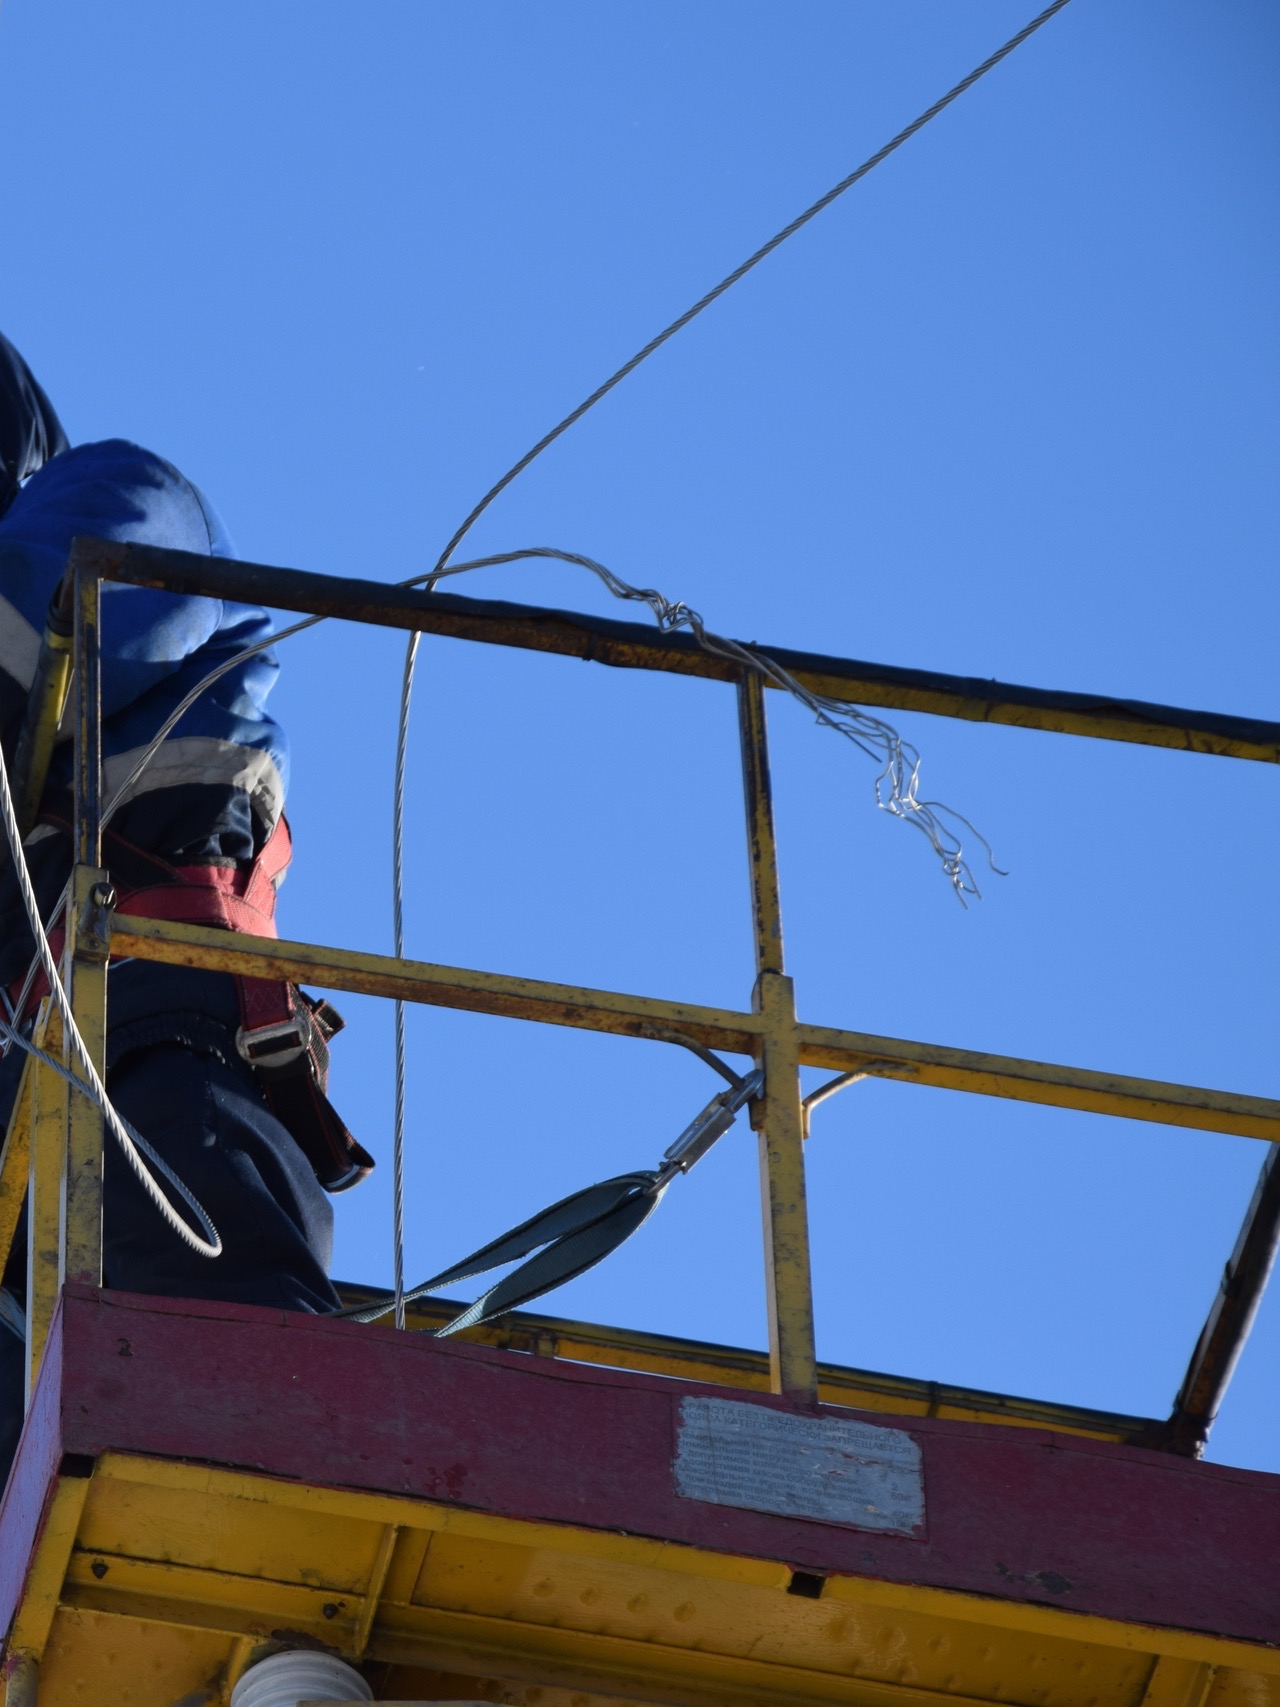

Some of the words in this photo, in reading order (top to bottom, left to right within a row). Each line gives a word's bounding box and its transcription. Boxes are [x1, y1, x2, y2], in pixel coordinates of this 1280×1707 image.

[688, 1402, 734, 1415] РАБОТА
[737, 1409, 758, 1419] БЕЗ
[762, 1413, 901, 1445] ПРЕДОХРАНИТЕЛЬНОГО
[724, 1416, 820, 1439] КАТЕГОРИЧЕСКИ
[823, 1433, 911, 1455] ЗАПРЕЩАЕТСЯ
